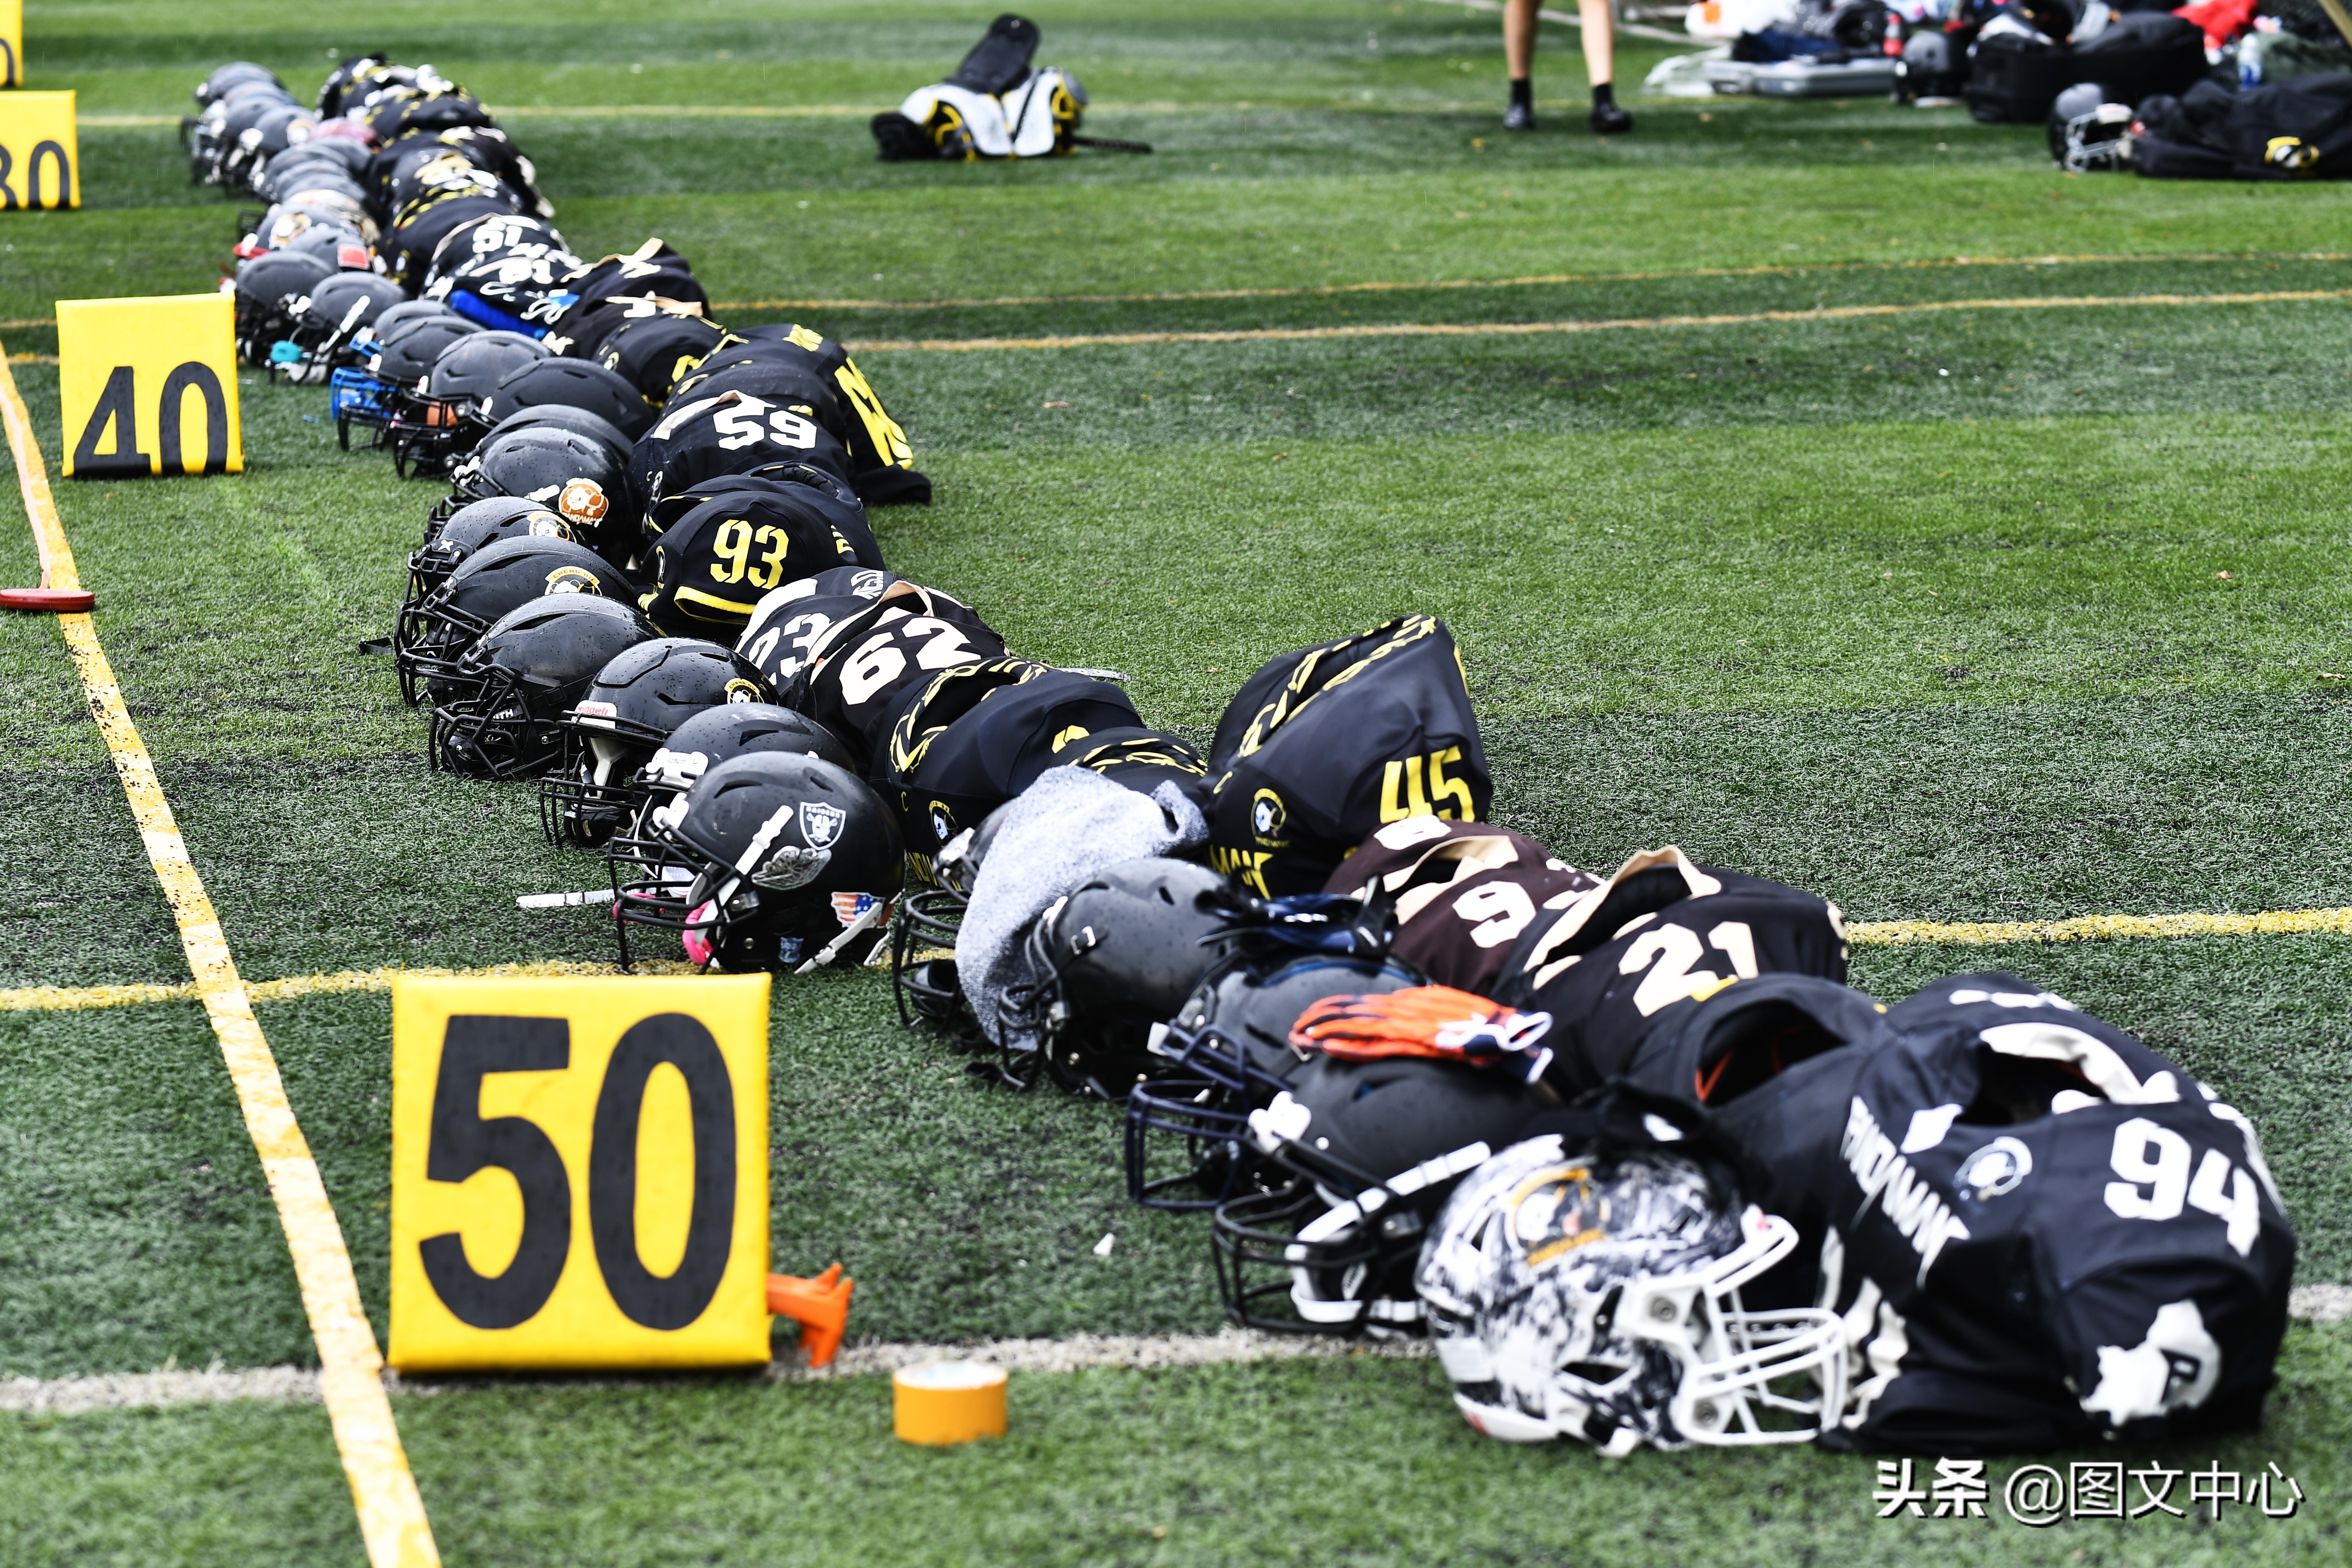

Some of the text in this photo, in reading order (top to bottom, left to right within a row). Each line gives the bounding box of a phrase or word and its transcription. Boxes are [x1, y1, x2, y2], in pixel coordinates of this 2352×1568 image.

[73, 361, 228, 477] 40
[713, 402, 817, 451] 59
[553, 569, 580, 578] CHENG
[710, 519, 789, 590] 93
[729, 681, 746, 689] CHENG
[839, 617, 981, 705] 62
[806, 806, 841, 819] RAIDERS
[1380, 745, 1475, 823] 45
[1452, 880, 1584, 949] 9
[1618, 921, 1759, 1018] 21
[419, 1012, 736, 1331] 50
[2104, 1116, 2260, 1257] 94
